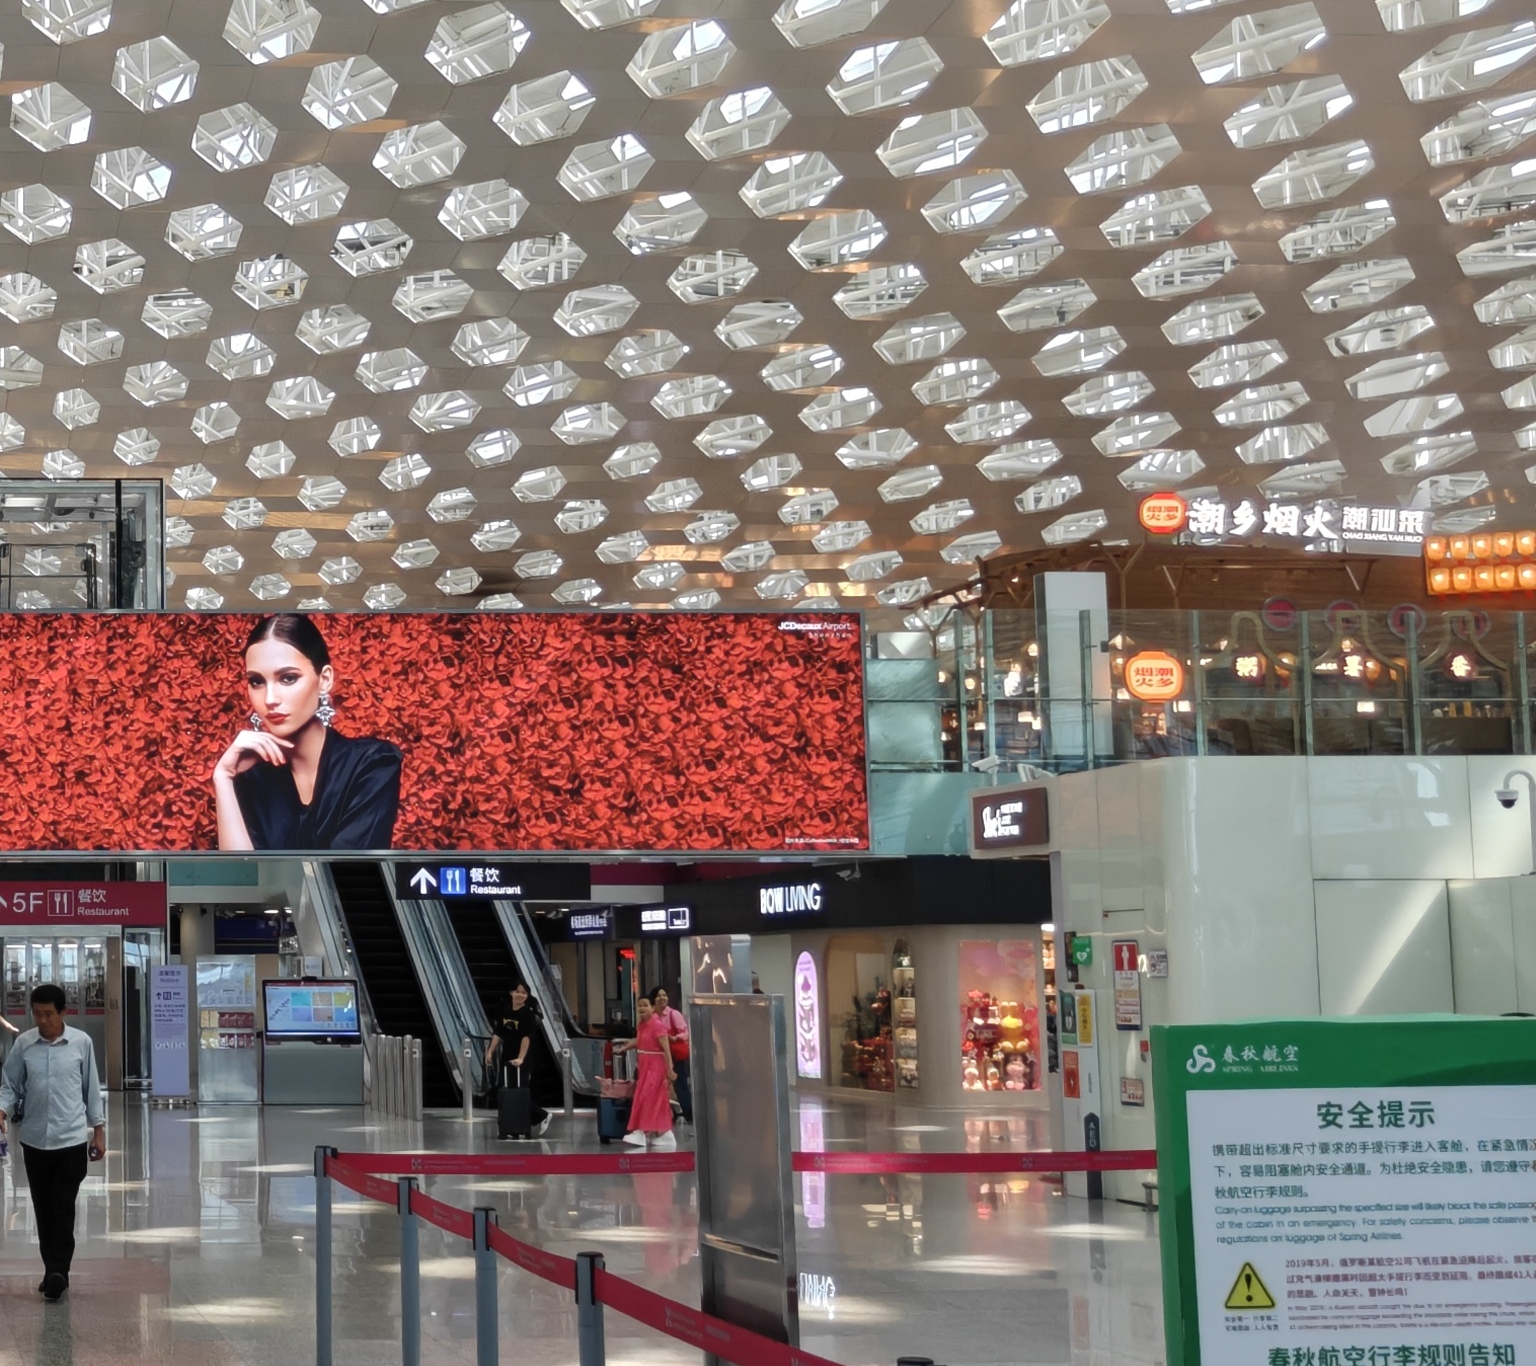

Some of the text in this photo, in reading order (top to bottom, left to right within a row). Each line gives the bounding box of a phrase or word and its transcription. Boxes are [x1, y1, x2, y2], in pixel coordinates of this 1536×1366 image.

[1186, 498, 1339, 539] 潮乡烟火
[1342, 506, 1424, 534] 潮汕菜
[823, 621, 851, 632] Airport
[469, 867, 500, 883] 餐饮
[77, 888, 107, 904] 餐饮
[470, 885, 521, 895] Restaurant
[785, 882, 822, 912] LIVING
[12, 892, 44, 913] 5F
[77, 906, 129, 917] Restaurant
[1221, 1044, 1299, 1063] 春秋航空
[1316, 1100, 1435, 1130] 安全提示
